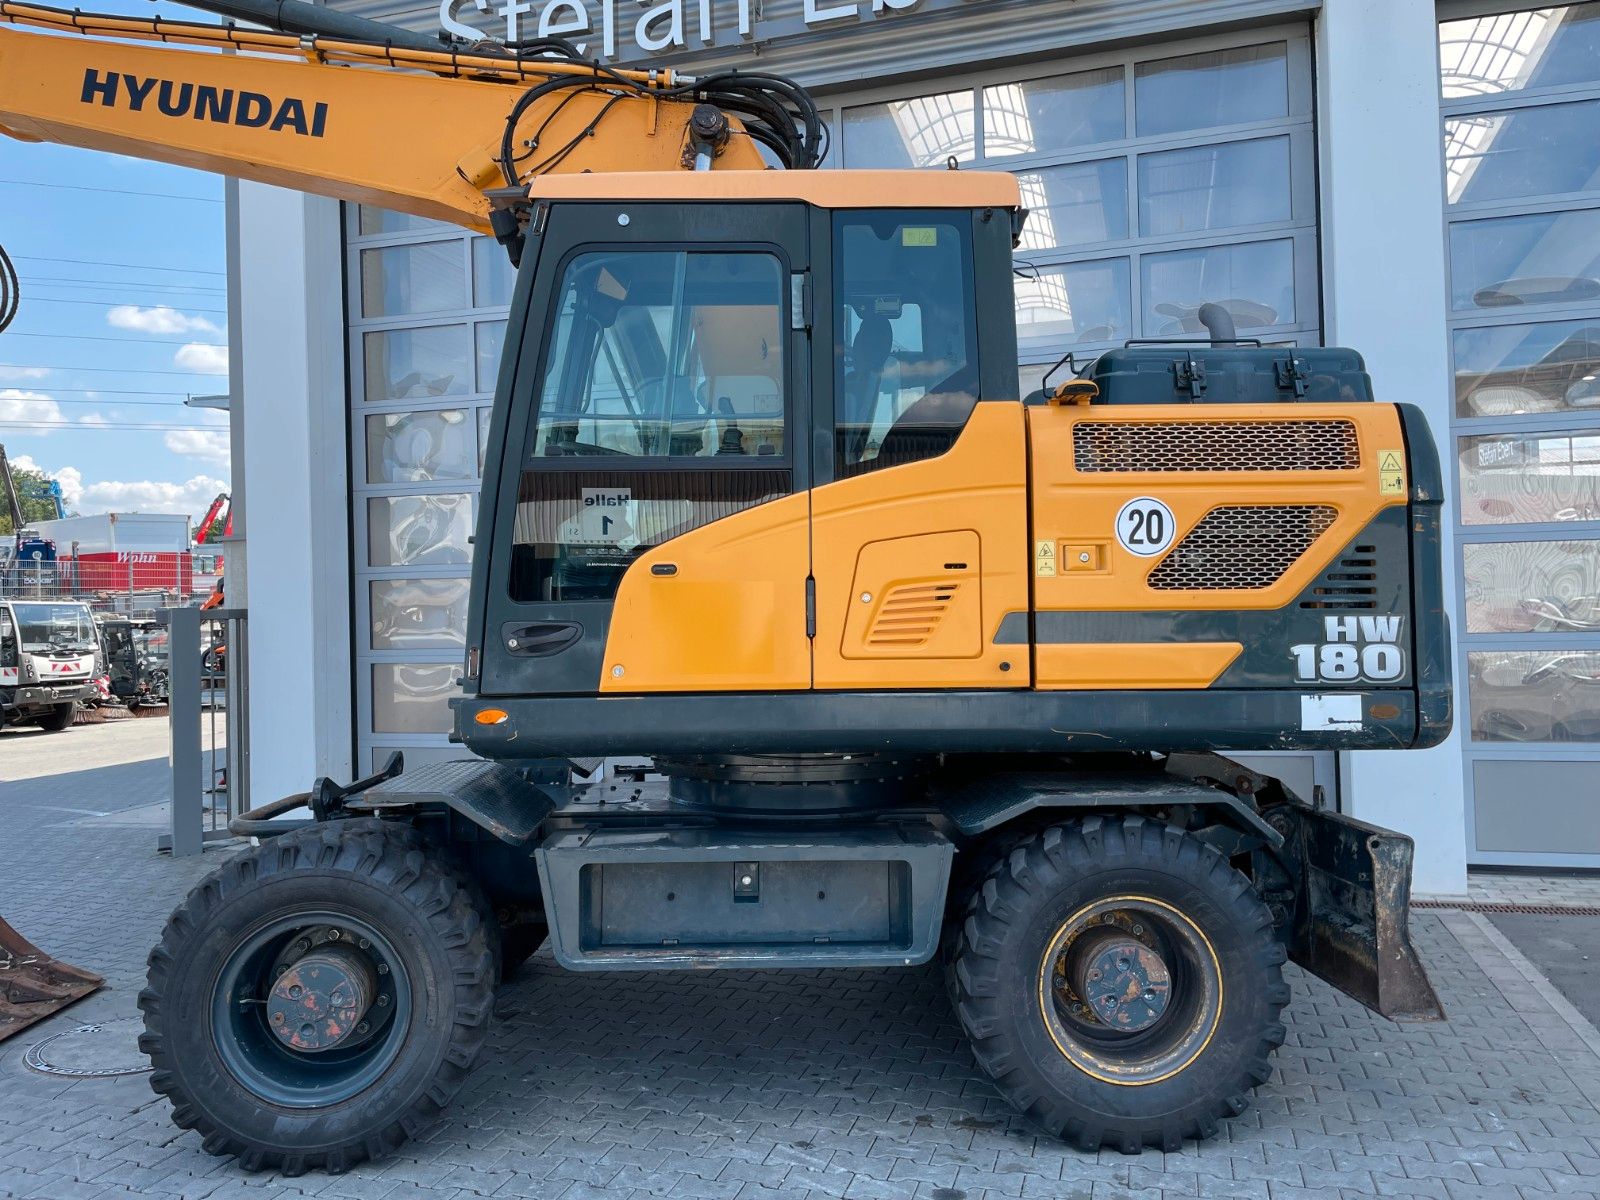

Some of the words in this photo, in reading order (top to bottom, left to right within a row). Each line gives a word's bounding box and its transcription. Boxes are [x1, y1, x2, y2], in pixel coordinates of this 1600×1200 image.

[80, 68, 329, 138] HYUNDAI
[1128, 508, 1164, 545] 20
[1324, 615, 1403, 642] HW
[1290, 643, 1405, 682] 180
